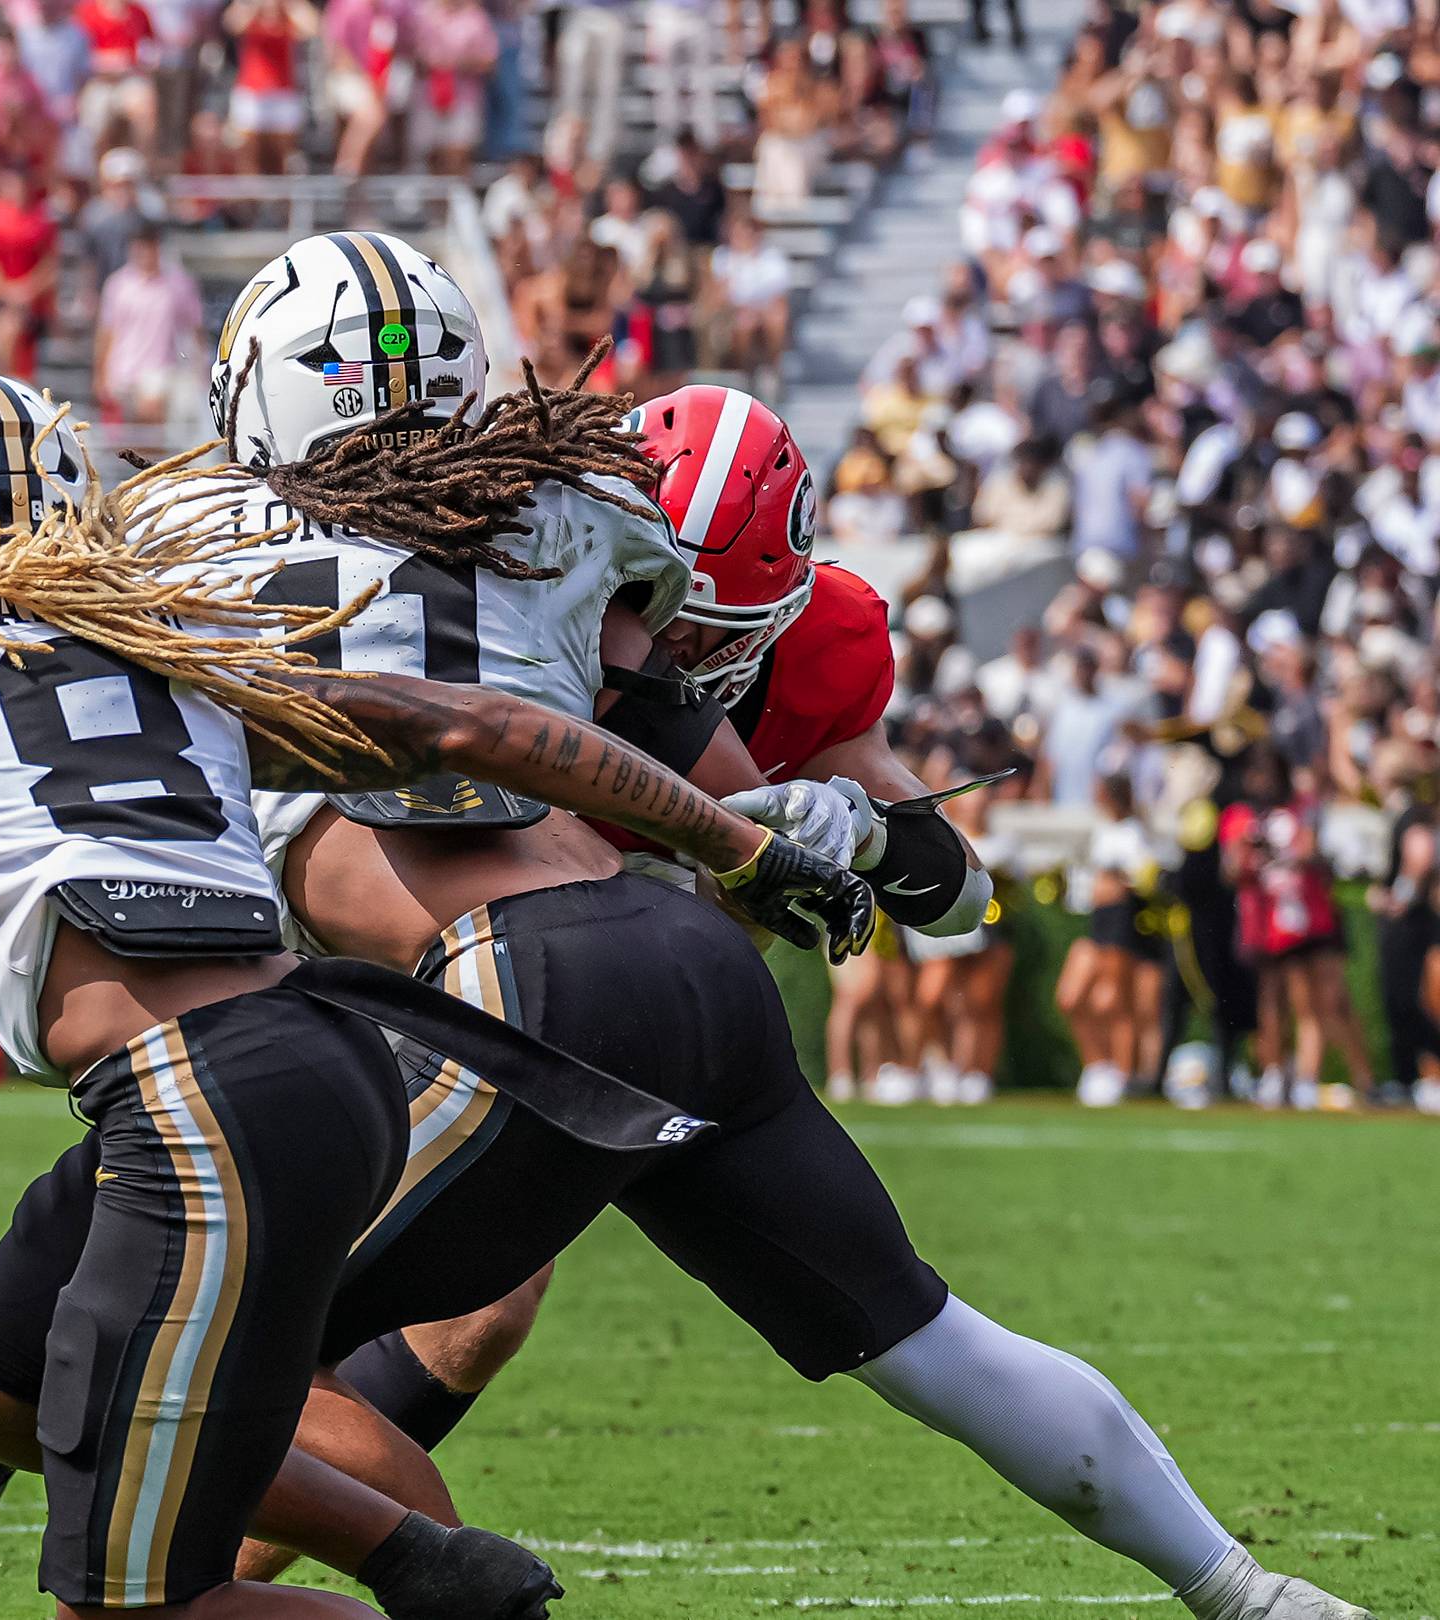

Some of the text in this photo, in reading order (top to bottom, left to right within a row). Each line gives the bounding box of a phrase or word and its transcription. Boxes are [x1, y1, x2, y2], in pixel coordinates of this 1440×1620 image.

[381, 333, 407, 345] C2P
[334, 389, 363, 417] SEC
[703, 622, 776, 670] BULLDOS
[524, 719, 583, 774] AM
[101, 879, 247, 908] Doug
